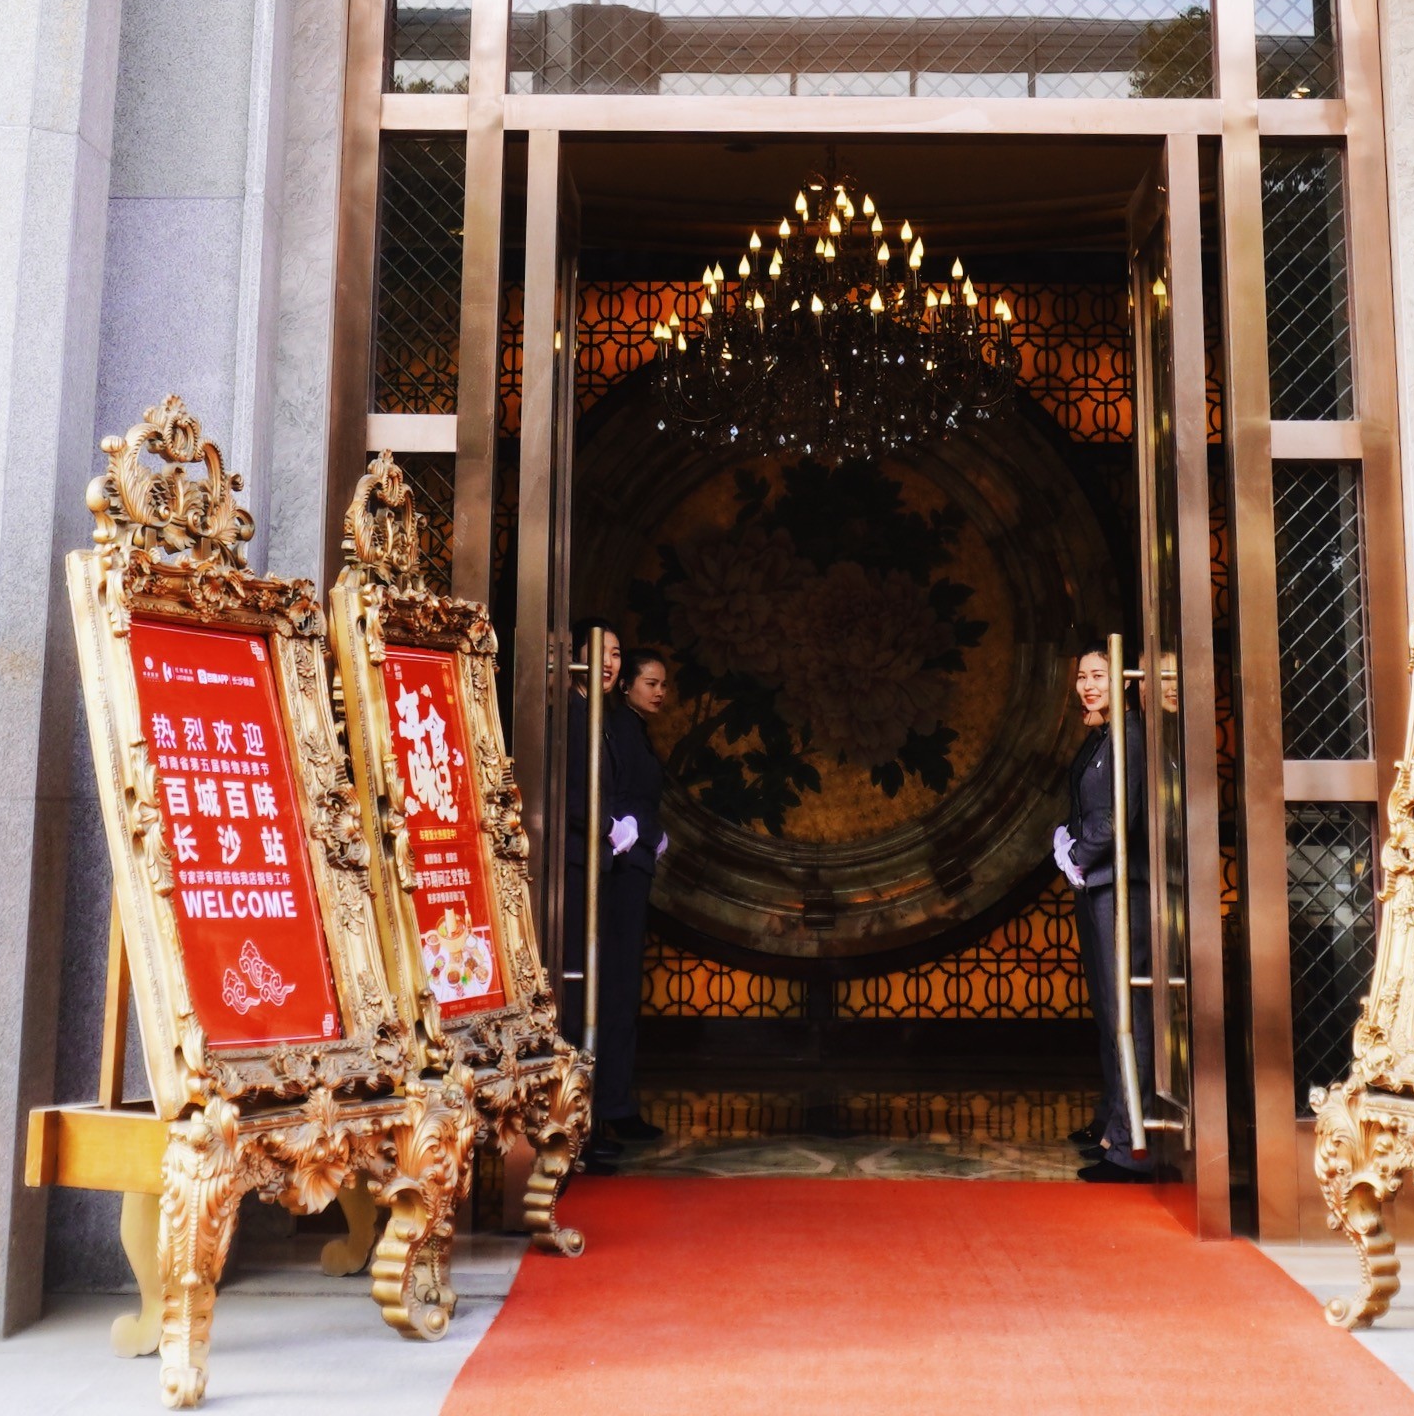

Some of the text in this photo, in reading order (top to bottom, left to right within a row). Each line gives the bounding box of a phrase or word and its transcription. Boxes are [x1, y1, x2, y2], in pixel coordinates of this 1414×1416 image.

[152, 713, 267, 757] 热烈欢迎
[158, 755, 270, 776] 湖南省第五届购物消费节
[163, 777, 279, 820] 百城百味
[173, 823, 288, 866] 长沙站
[178, 870, 291, 886] 专家评审团莅临我店指导工作
[181, 890, 298, 919] WELCOME
